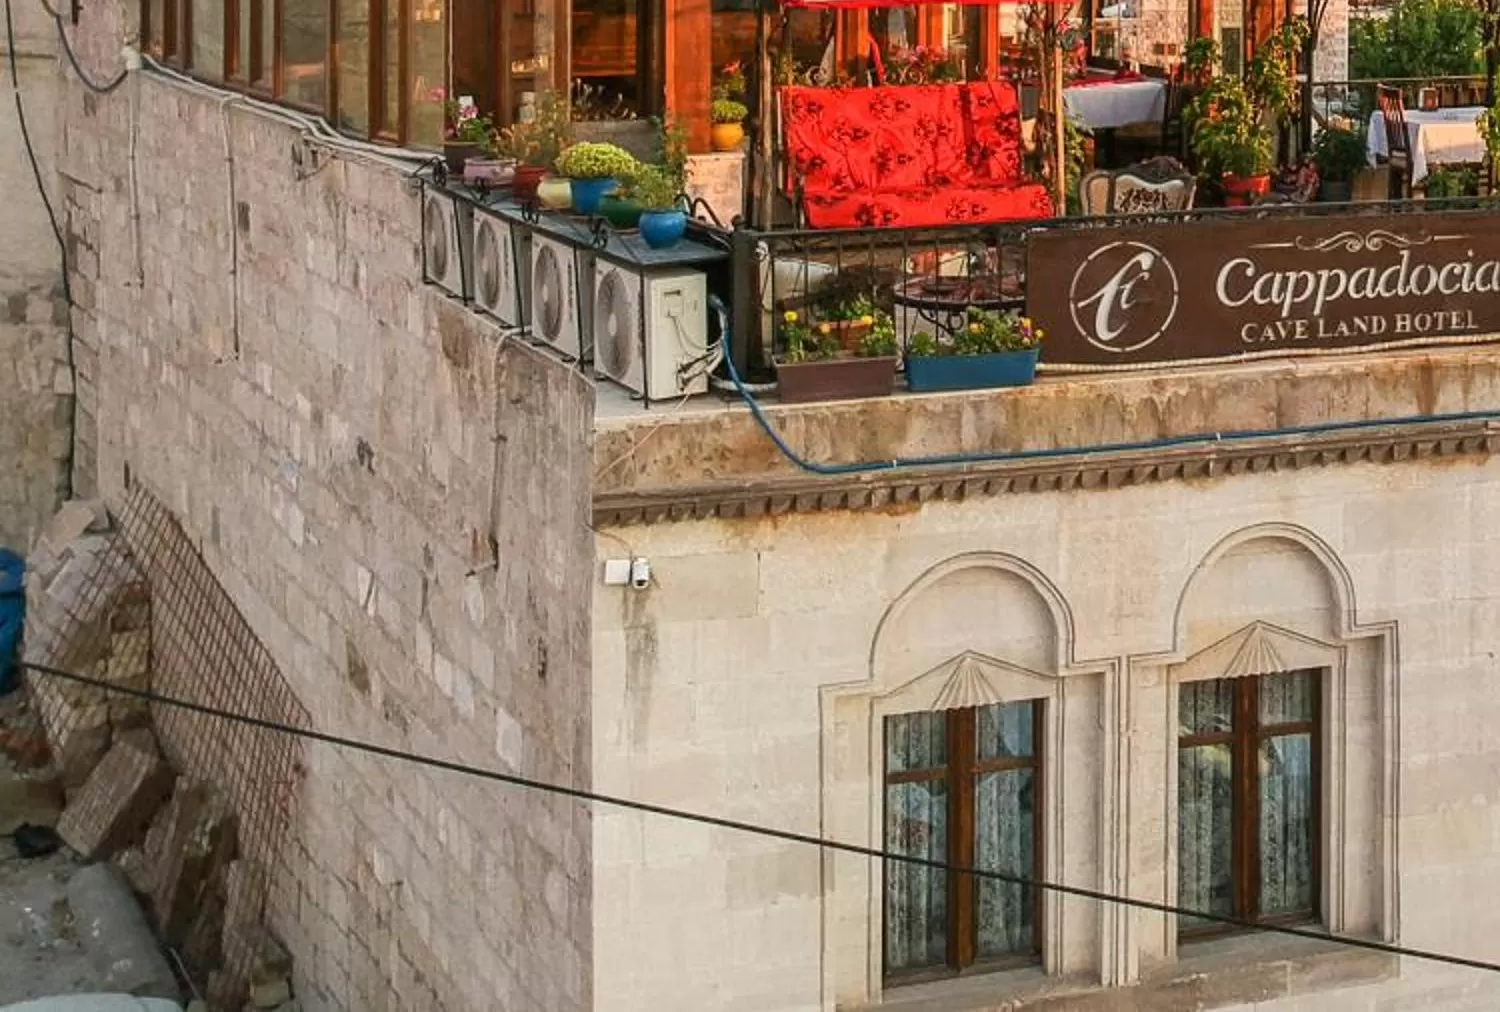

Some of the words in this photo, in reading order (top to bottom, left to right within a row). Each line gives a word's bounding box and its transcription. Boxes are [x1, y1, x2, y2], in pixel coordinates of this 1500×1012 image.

[1241, 319, 1309, 343] CAVE
[1318, 315, 1387, 338] LAND
[1394, 309, 1480, 333] HOTEL
